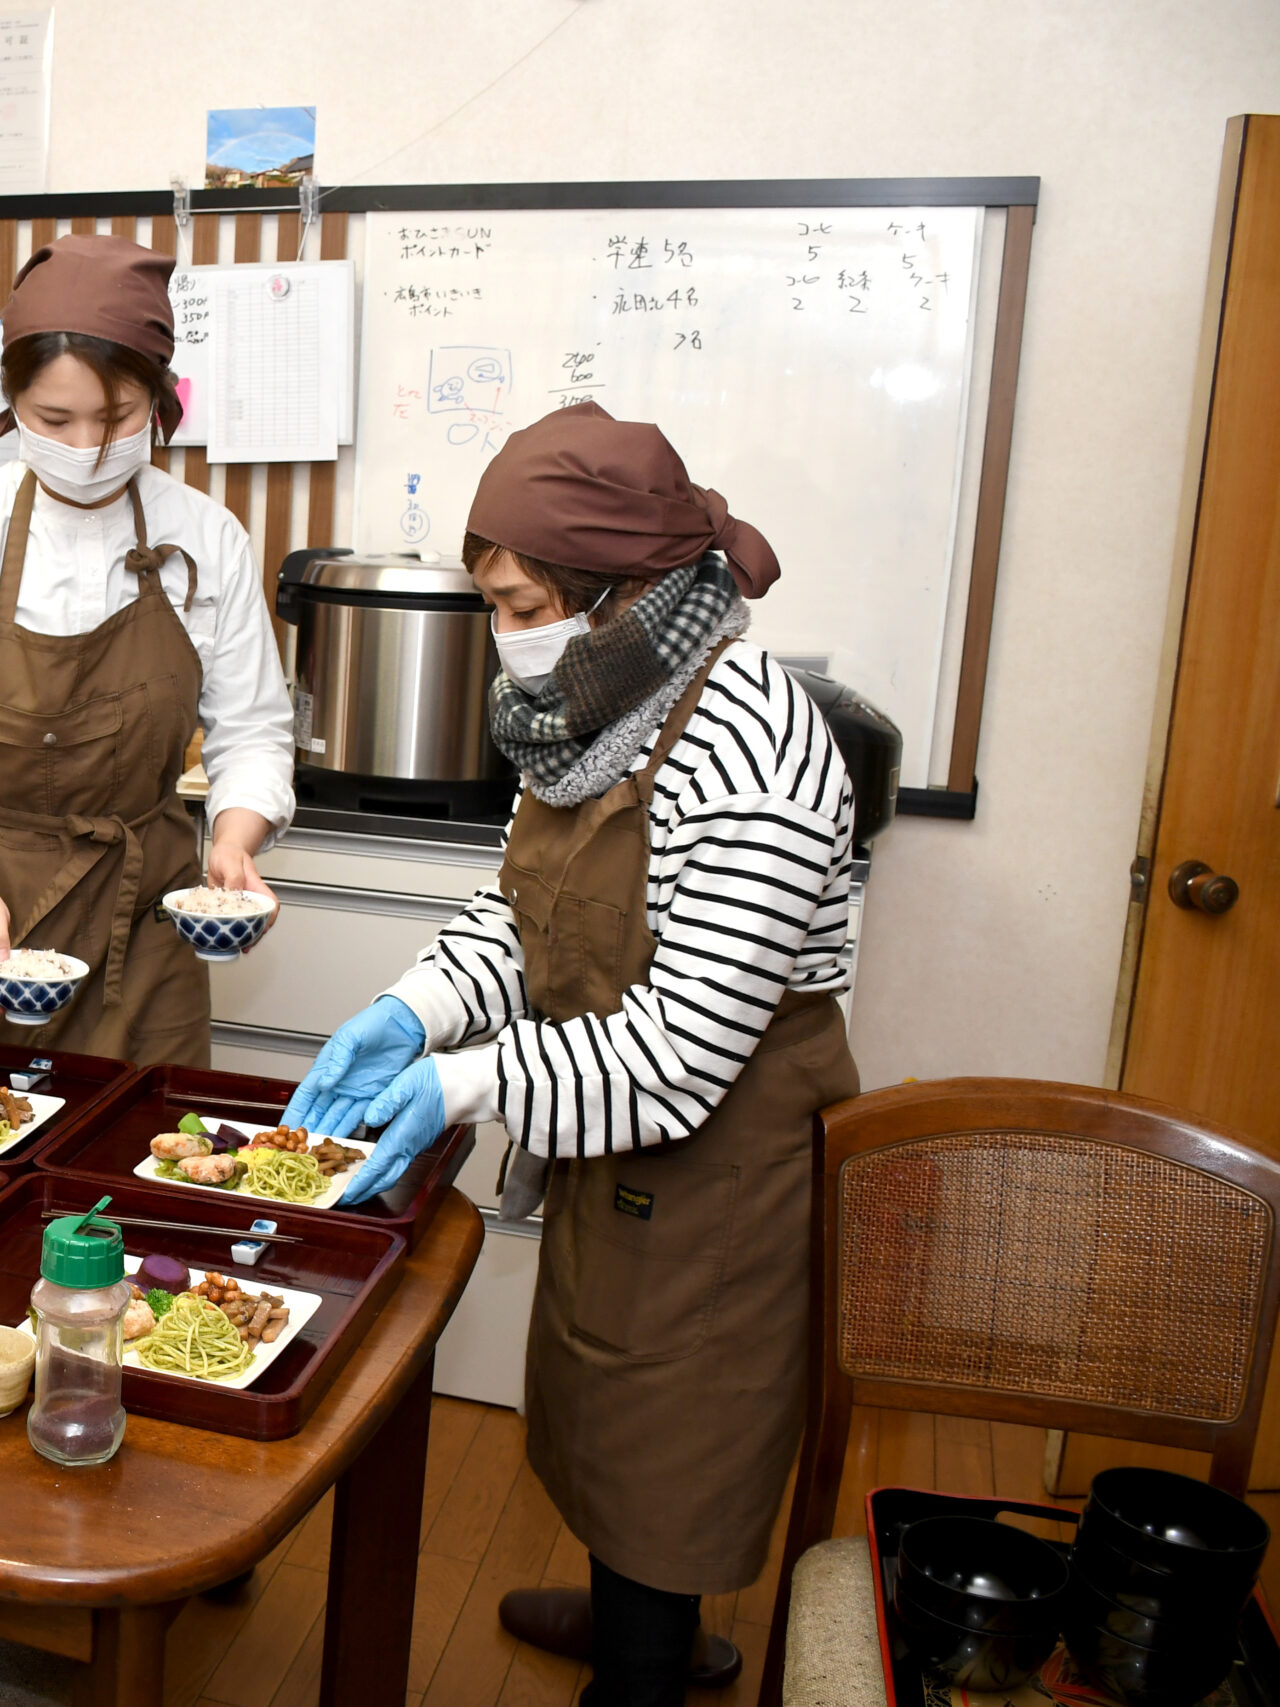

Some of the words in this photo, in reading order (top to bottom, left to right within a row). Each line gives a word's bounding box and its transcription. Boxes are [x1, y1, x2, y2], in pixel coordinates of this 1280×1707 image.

[401, 243, 492, 260] ポイントカード
[807, 245, 822, 262] 5
[902, 253, 917, 269] 5
[838, 269, 872, 291] 紅茶
[394, 285, 483, 303] 広島市いきいき
[408, 303, 454, 318] ポイント
[791, 297, 805, 311] 2
[848, 295, 867, 313] 2
[919, 296, 932, 311] 2
[570, 369, 593, 383] 600
